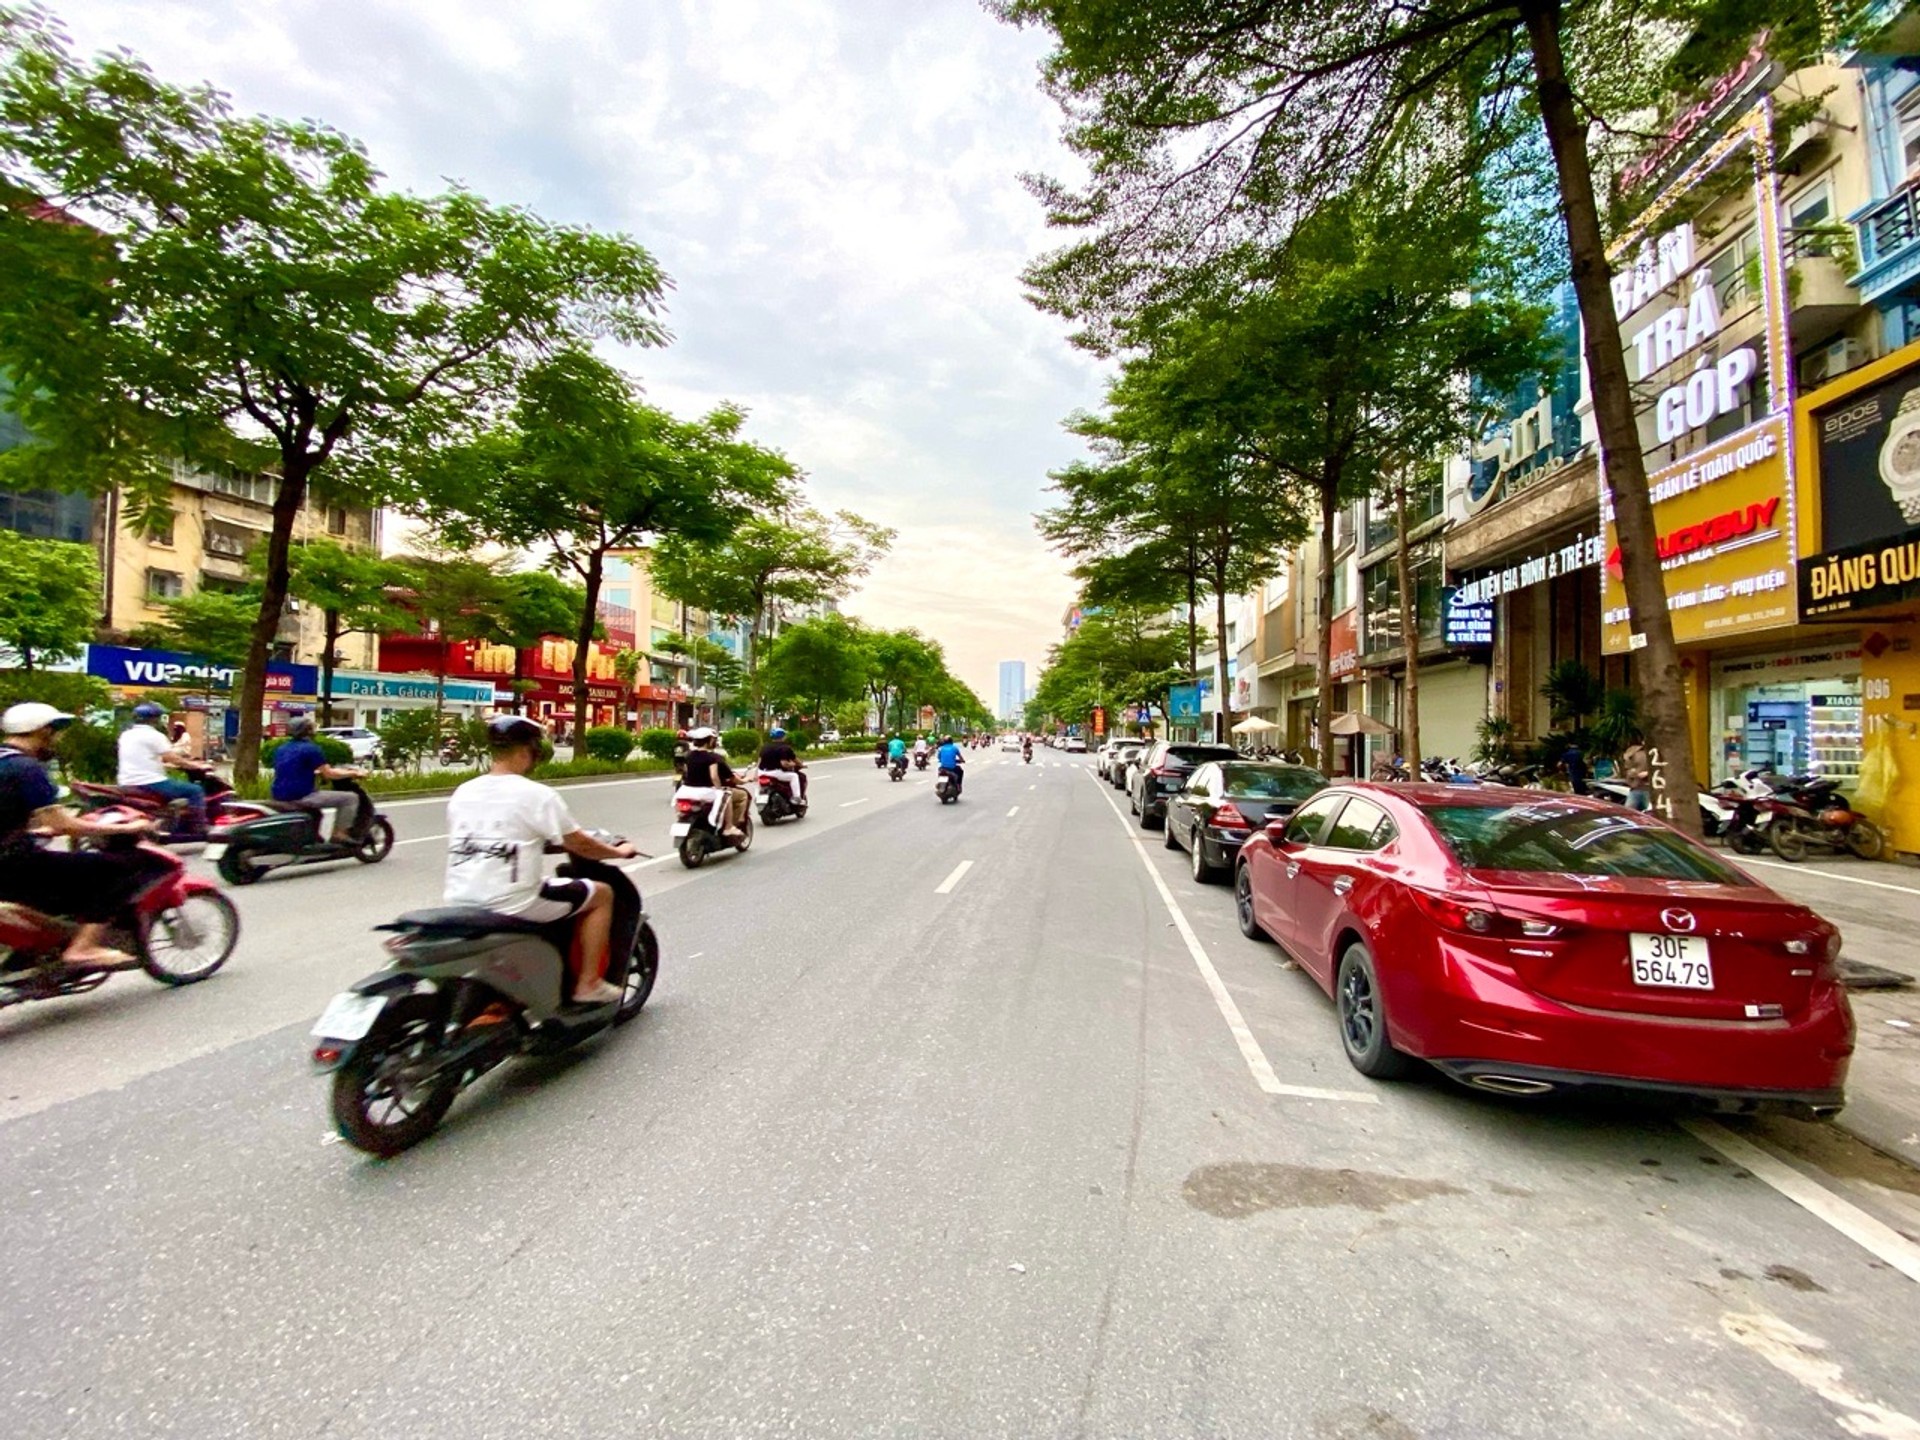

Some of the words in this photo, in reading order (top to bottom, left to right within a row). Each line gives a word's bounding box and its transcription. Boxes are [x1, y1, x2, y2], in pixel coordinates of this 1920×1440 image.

[1609, 221, 1693, 322] BÁN
[1632, 268, 1722, 380] TRẢ
[1657, 348, 1757, 443] GÓP
[1825, 400, 1879, 431] epos
[1655, 477, 1681, 500] BÁN
[1683, 461, 1699, 491] LẺ
[1700, 453, 1734, 483] TOÀN
[1737, 430, 1777, 469] QUỐC
[1656, 497, 1780, 559] LICKBUY
[1502, 567, 1518, 594] GIA
[1521, 556, 1546, 587] ĐÌNH
[1549, 552, 1557, 577] &
[1560, 532, 1583, 573] TRẺ
[1811, 555, 1877, 600] ĐĂNG
[1881, 541, 1920, 584] QU
[1866, 678, 1890, 700] 096
[1636, 959, 1710, 986] 564.79
[1650, 936, 1689, 960] 30F
